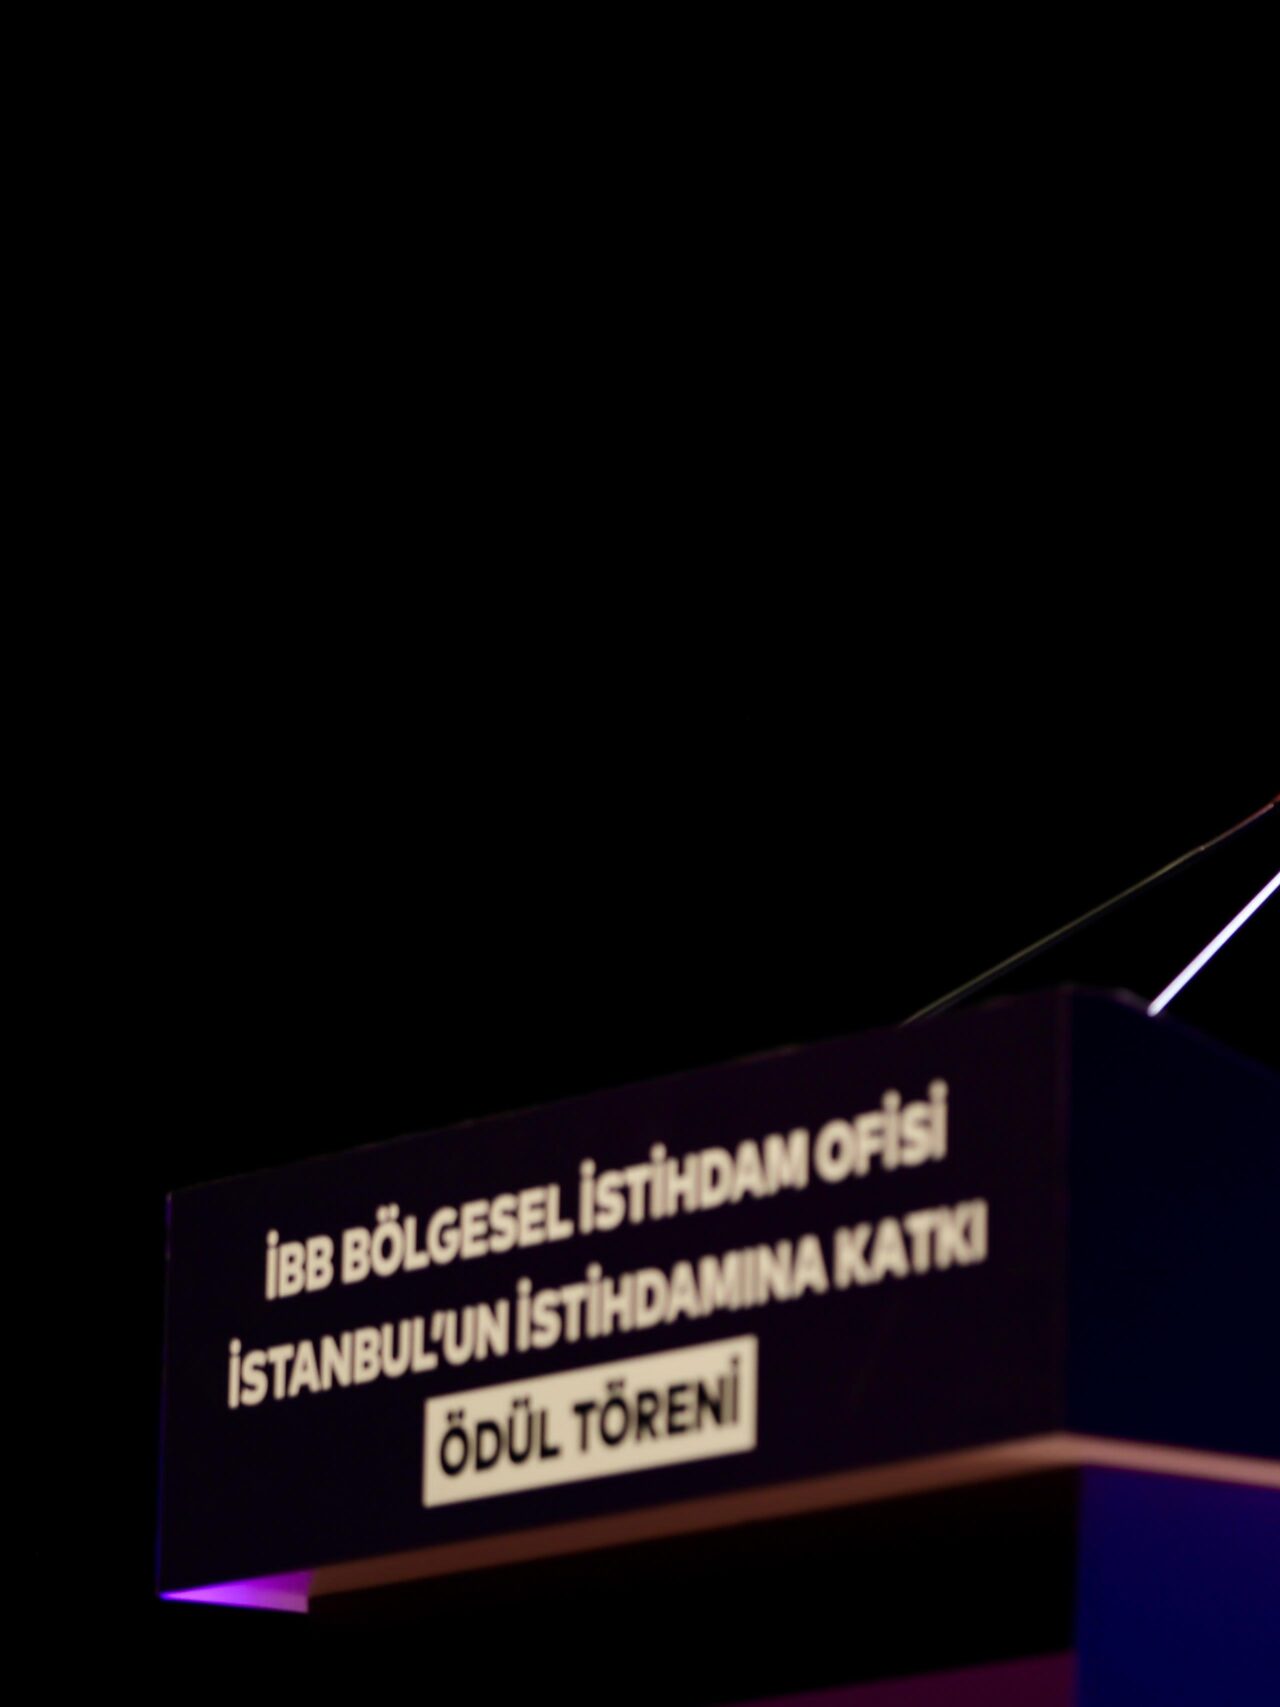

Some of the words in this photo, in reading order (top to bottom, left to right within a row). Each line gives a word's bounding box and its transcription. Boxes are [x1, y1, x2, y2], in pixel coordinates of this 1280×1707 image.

[265, 1229, 335, 1301] İBB
[341, 1183, 574, 1285] BÖLGESEL
[578, 1129, 810, 1235] İSTİHDAM
[813, 1080, 948, 1183] OFİSİ
[515, 1234, 829, 1352] İSTİHDAMINA
[833, 1199, 988, 1289] KATKI
[438, 1398, 561, 1477] ÖDÜL
[572, 1357, 741, 1451] TÖRENİ
